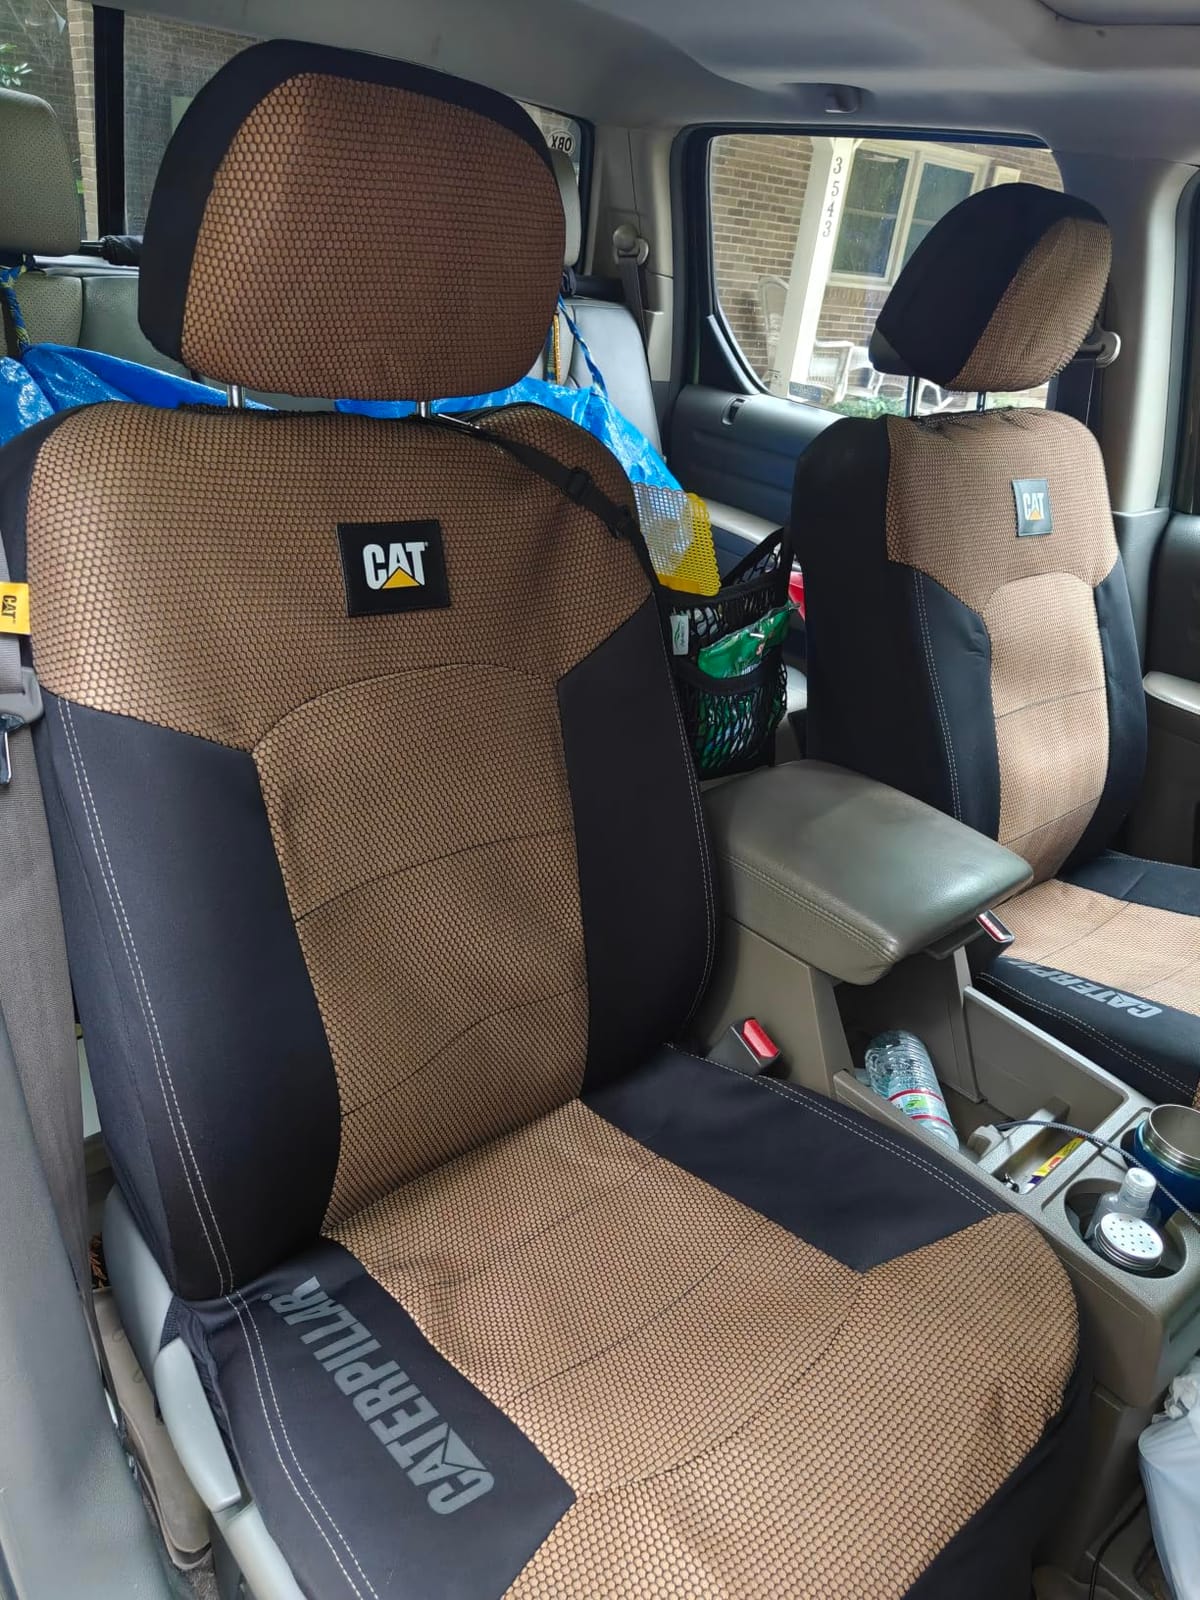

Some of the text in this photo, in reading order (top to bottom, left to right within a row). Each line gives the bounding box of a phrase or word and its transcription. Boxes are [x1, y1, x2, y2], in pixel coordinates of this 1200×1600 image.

[822, 156, 843, 238] 3543
[1022, 492, 1045, 520] CAT
[363, 541, 426, 590] CAT
[1, 595, 17, 618] CAT
[268, 1276, 495, 1515] CATERPILLAR
